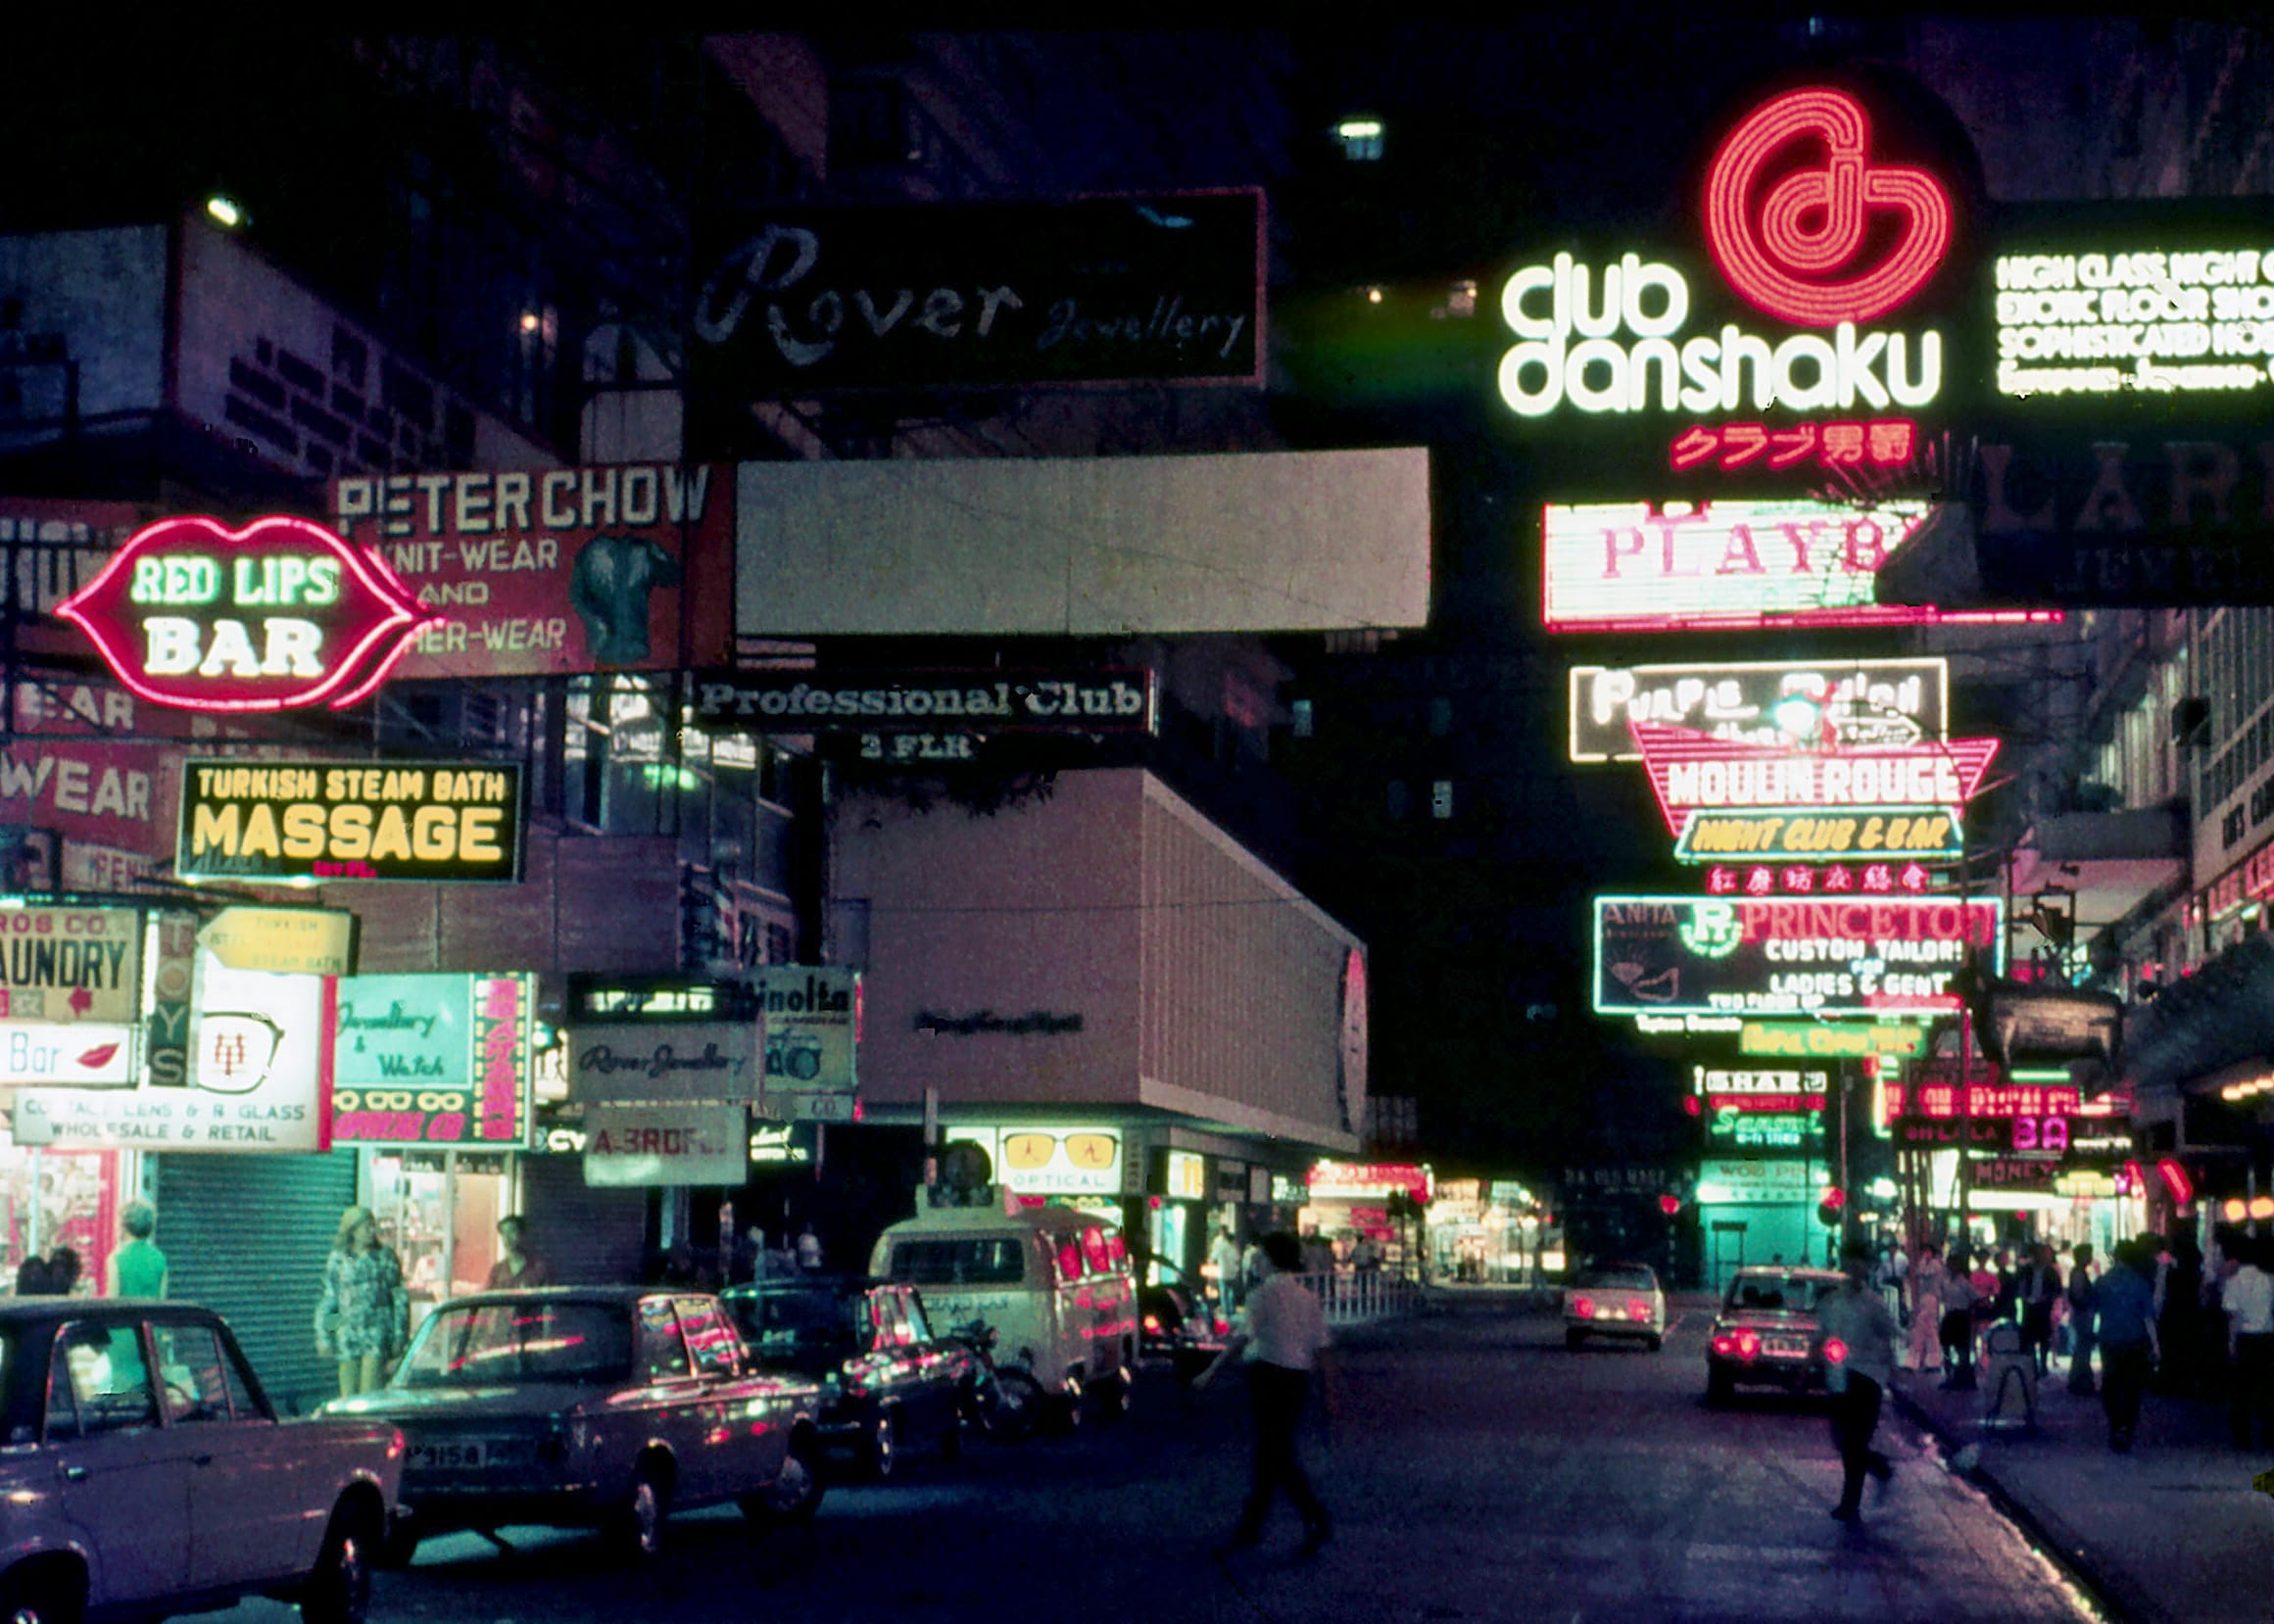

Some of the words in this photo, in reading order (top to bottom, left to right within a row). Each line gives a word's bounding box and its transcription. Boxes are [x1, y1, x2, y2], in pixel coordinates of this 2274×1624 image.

[2077, 254, 2167, 287] CLASS
[2169, 251, 2260, 285] NIGHT
[693, 222, 1024, 367] Rover
[1036, 296, 1245, 358] Jewellery
[1501, 252, 1689, 338] club
[1497, 319, 1943, 417] danshaku
[338, 470, 530, 536] PETER
[542, 464, 709, 529] CHOW
[380, 539, 559, 573] NIT-WEAR
[131, 555, 218, 604] RED
[233, 554, 341, 605] LIPS
[416, 581, 490, 605] AND
[144, 617, 324, 677] BAR
[702, 684, 1011, 716] Professional
[1025, 683, 1142, 716] Club
[0, 751, 150, 821] WEAR
[198, 769, 317, 799] TURKISH
[325, 769, 423, 801] STEAM
[432, 770, 506, 801] BATH
[1669, 759, 1814, 805] MOULIN
[1824, 757, 1960, 803] ROUGE
[192, 802, 504, 861] MASSAGE
[1692, 819, 1783, 851] NIGHT
[1783, 818, 1859, 851] CLUB
[1886, 817, 1950, 849] BAR
[1743, 902, 1993, 943] PRINCETON
[1765, 938, 1865, 961] CUSTOM
[151, 918, 196, 1083] TOYS
[734, 975, 849, 1013] inolta
[1770, 973, 1853, 995] LADIES
[1885, 972, 1952, 997] GENT
[10, 1032, 62, 1074] Bar
[377, 1053, 445, 1076] Watch
[123, 1102, 172, 1118] LENS
[239, 1103, 306, 1122] GLASS
[182, 1123, 195, 1140] &
[208, 1123, 276, 1142] RETAIL
[1014, 1174, 1105, 1187] OPTICAL
